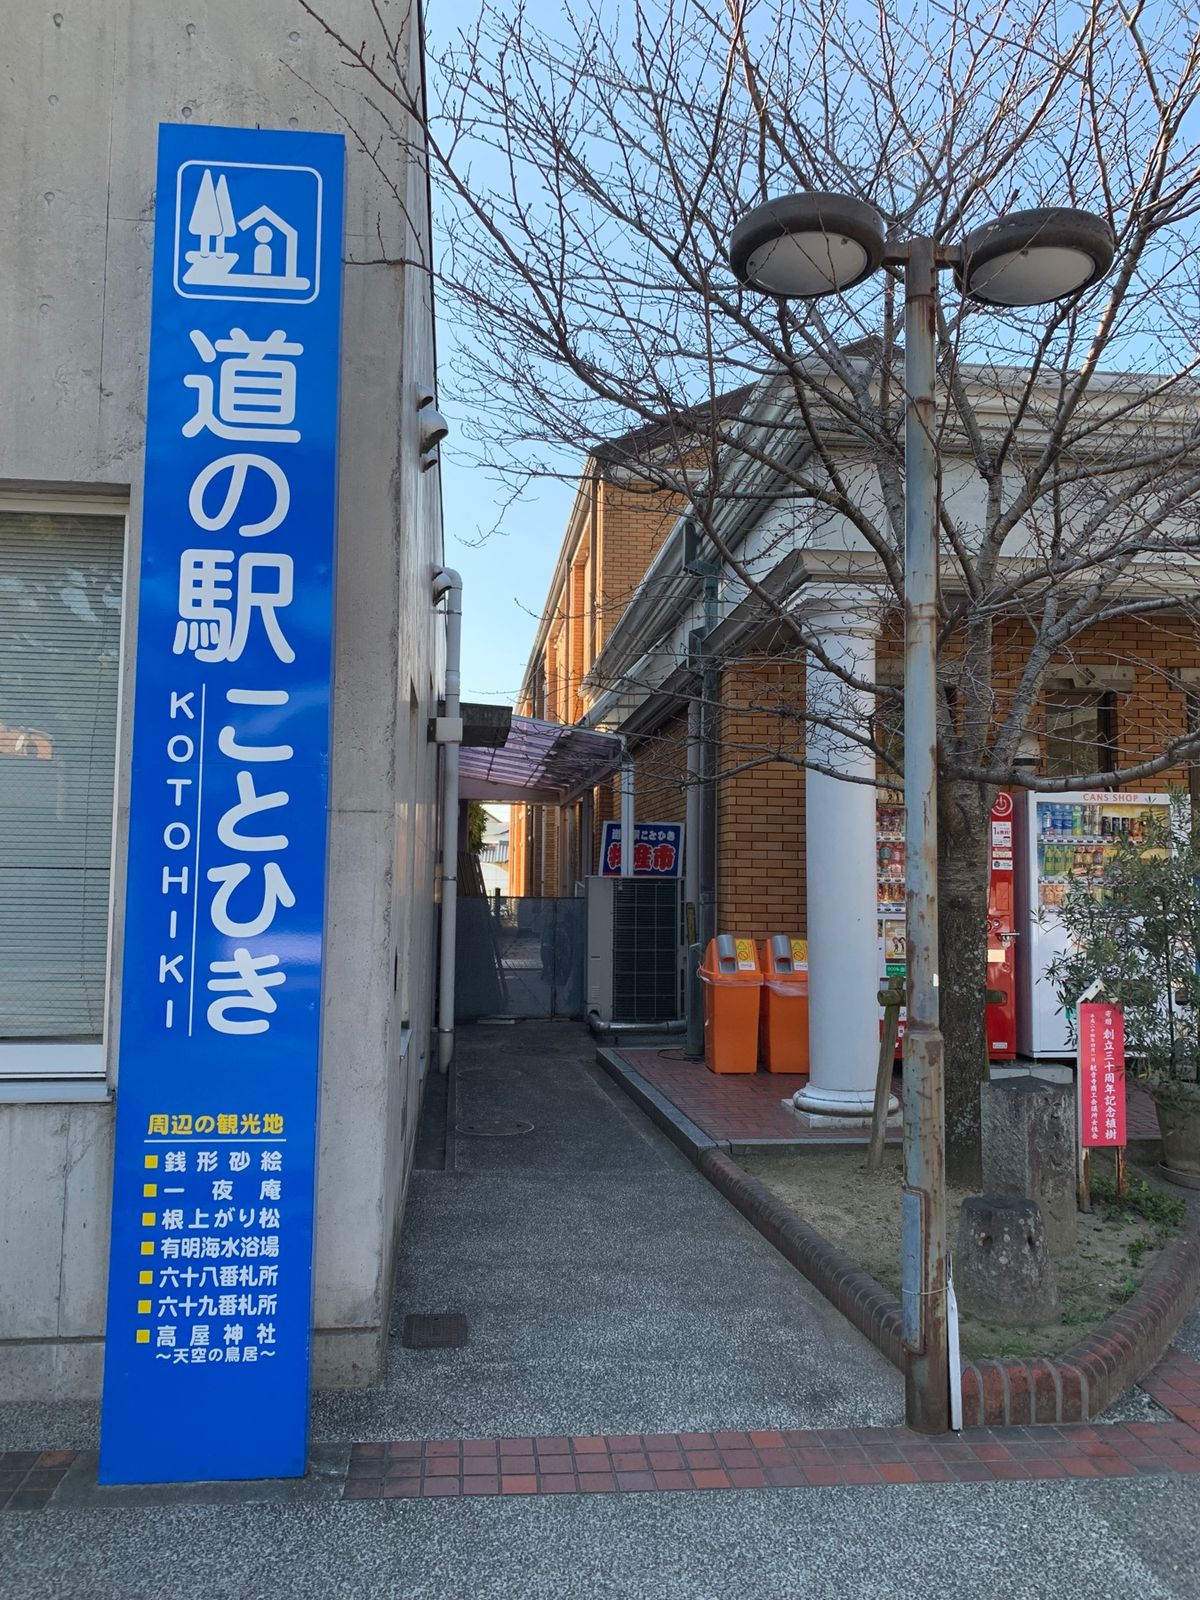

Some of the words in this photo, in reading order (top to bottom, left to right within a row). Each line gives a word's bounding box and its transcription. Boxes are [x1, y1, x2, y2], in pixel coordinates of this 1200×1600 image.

[1083, 793, 1109, 801] CANS
[1112, 794, 1138, 802] SHOP
[159, 691, 195, 1029] KOTOHIKI
[1103, 1028, 1117, 1140] 創立三十周年記念植樹
[147, 1113, 284, 1136] 周辺の観光地
[164, 1150, 283, 1173] 銭形砂絵
[163, 1179, 282, 1201] 一夜庵
[161, 1207, 280, 1229] 根上がり松
[160, 1236, 280, 1259] 有明海水浴場
[159, 1265, 279, 1288] 六十八番札所
[158, 1293, 278, 1317] 六十九番札所
[156, 1323, 276, 1347] 高屋神社
